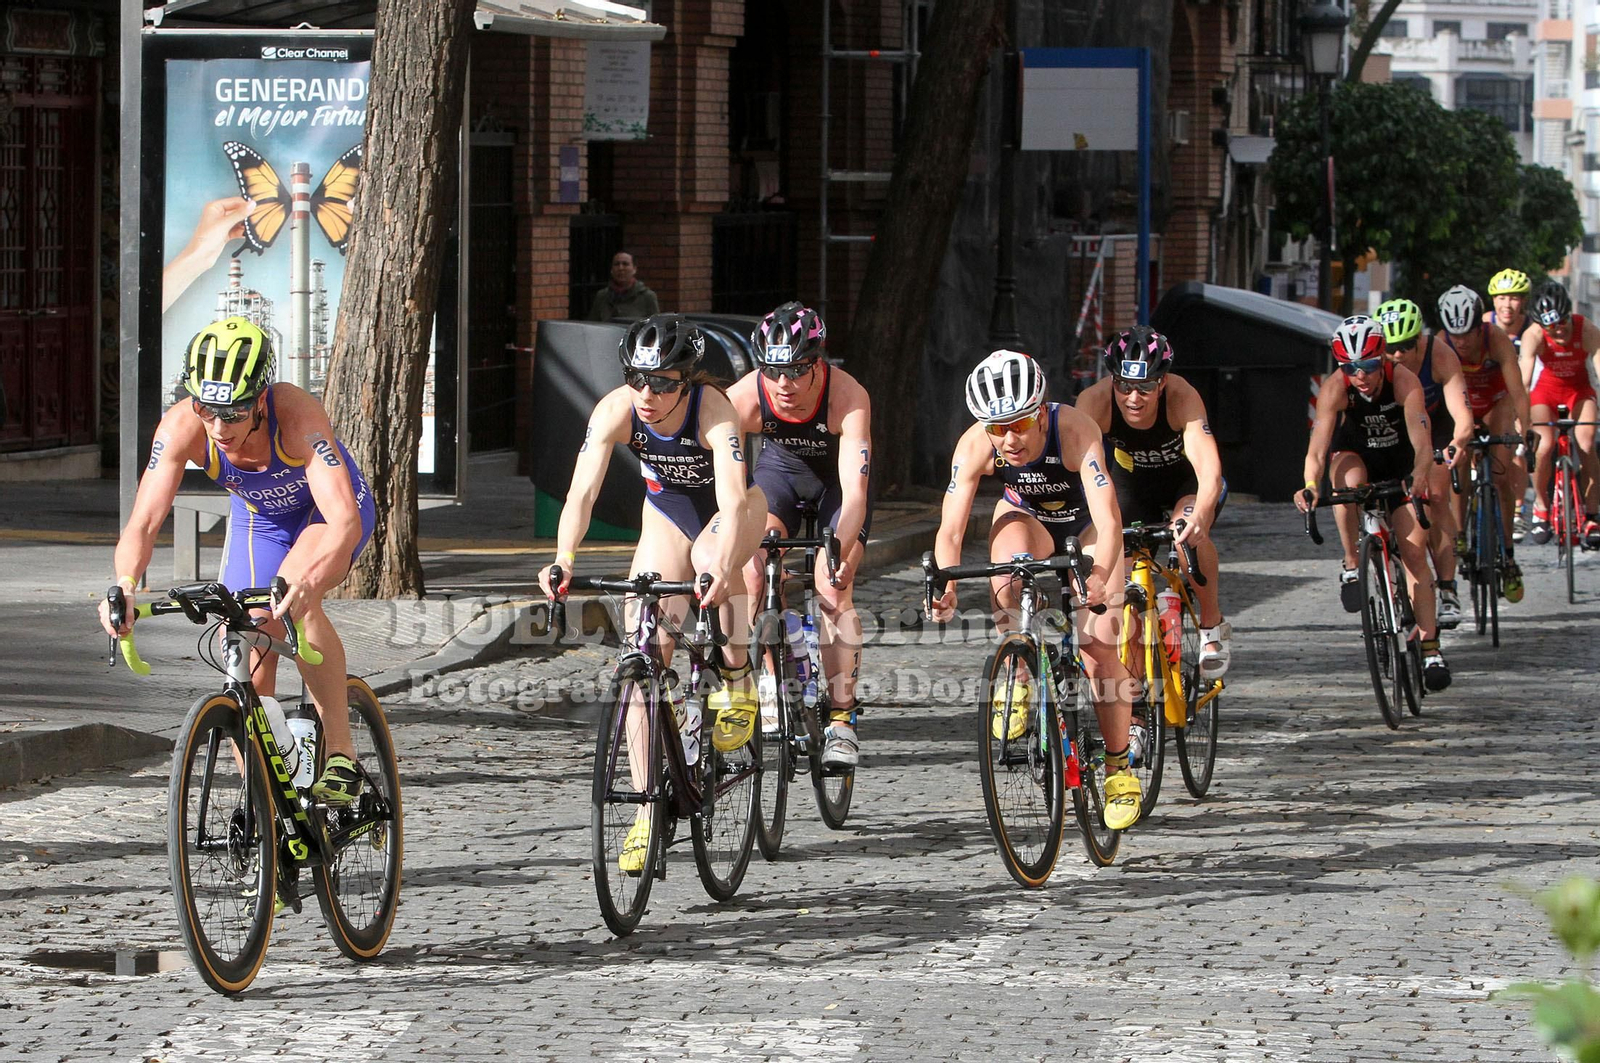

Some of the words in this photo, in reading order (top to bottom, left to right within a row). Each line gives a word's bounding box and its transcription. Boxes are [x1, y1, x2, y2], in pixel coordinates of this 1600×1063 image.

[277, 47, 305, 59] Clear
[305, 47, 349, 60] Channel
[215, 78, 369, 102] GENERAND
[214, 105, 236, 127] el
[237, 104, 308, 140] Mejor
[1383, 312, 1399, 323] 15
[1451, 317, 1465, 327] 10
[769, 347, 792, 363] 14
[1128, 363, 1141, 376] 9
[202, 384, 231, 402] 28
[990, 398, 1013, 415] 12
[727, 436, 745, 463] 30
[773, 437, 828, 448] MATHIAS
[147, 440, 166, 470] 28
[312, 439, 343, 468] 28
[859, 449, 870, 478] 14
[271, 468, 292, 480] TYR
[946, 465, 960, 494] 12
[1088, 460, 1109, 489] 12
[238, 476, 309, 502] NORDEN
[263, 495, 300, 511] SWE
[1183, 506, 1195, 518] 9
[851, 652, 859, 678] 14
[348, 821, 376, 839] SCOTT
